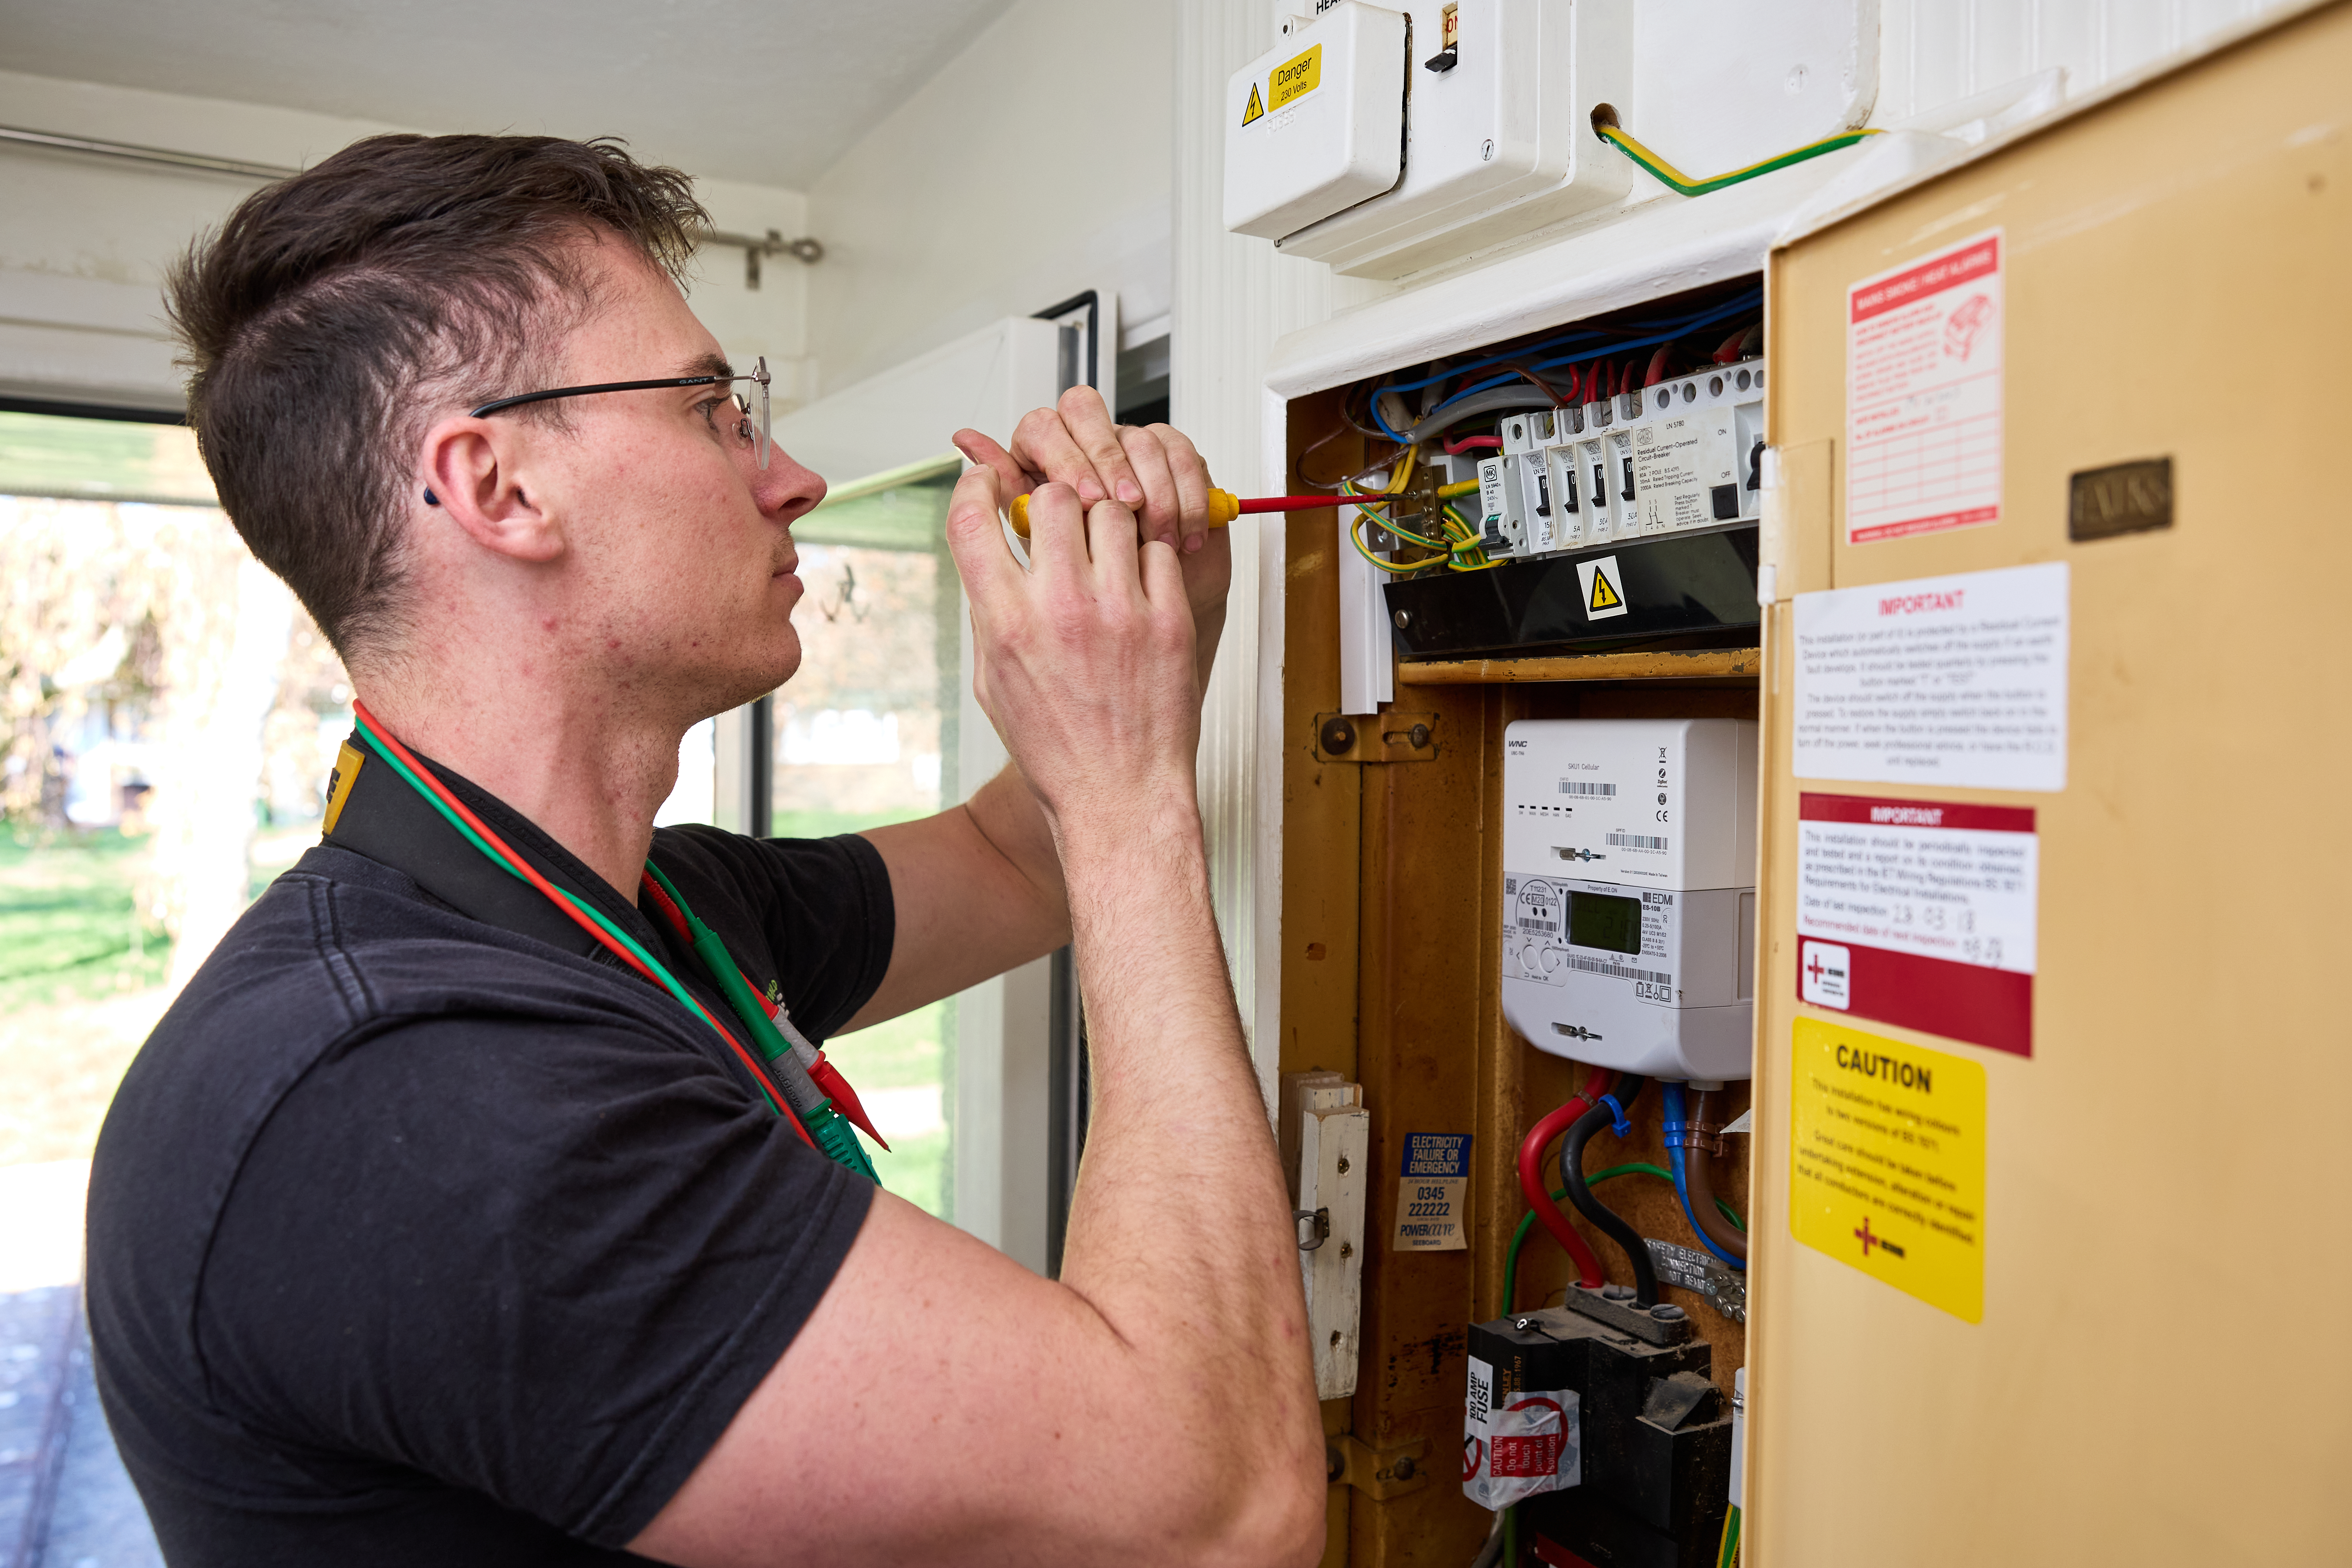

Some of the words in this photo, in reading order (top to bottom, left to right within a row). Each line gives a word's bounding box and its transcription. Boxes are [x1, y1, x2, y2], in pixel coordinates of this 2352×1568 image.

[1317, 0, 1340, 15] HEA
[1278, 57, 1312, 86] Danger
[1281, 88, 1291, 102] 230
[1293, 80, 1307, 94] Volts
[1267, 107, 1296, 138] FUSES
[1637, 446, 1656, 456] Residual
[1657, 438, 1698, 452] Current-Operated
[1638, 452, 1670, 462] Circuit-Breaker
[1878, 589, 1966, 617] IMPORTANT
[1870, 806, 1944, 825] IMPORTANT
[1533, 896, 1543, 904] M20
[1545, 898, 1557, 906] 0122
[1653, 893, 1673, 905] EDMI
[1836, 1044, 1932, 1094] CAUTION
[774, 1069, 802, 1107] Megger
[1412, 1136, 1464, 1149] ELECTRICITY
[1413, 1149, 1445, 1161] FAILURE
[1447, 1149, 1459, 1161] OR
[1409, 1161, 1460, 1174] EMERGENCY
[1418, 1187, 1445, 1200] 0345
[1408, 1202, 1450, 1216] 222222
[1477, 1378, 1488, 1425] FUSE
[1508, 1442, 1517, 1456] not
[1535, 1439, 1543, 1448] of
[1493, 1437, 1503, 1476] CAUTION
[1522, 1445, 1530, 1469] touch
[1507, 1459, 1516, 1470] Do
